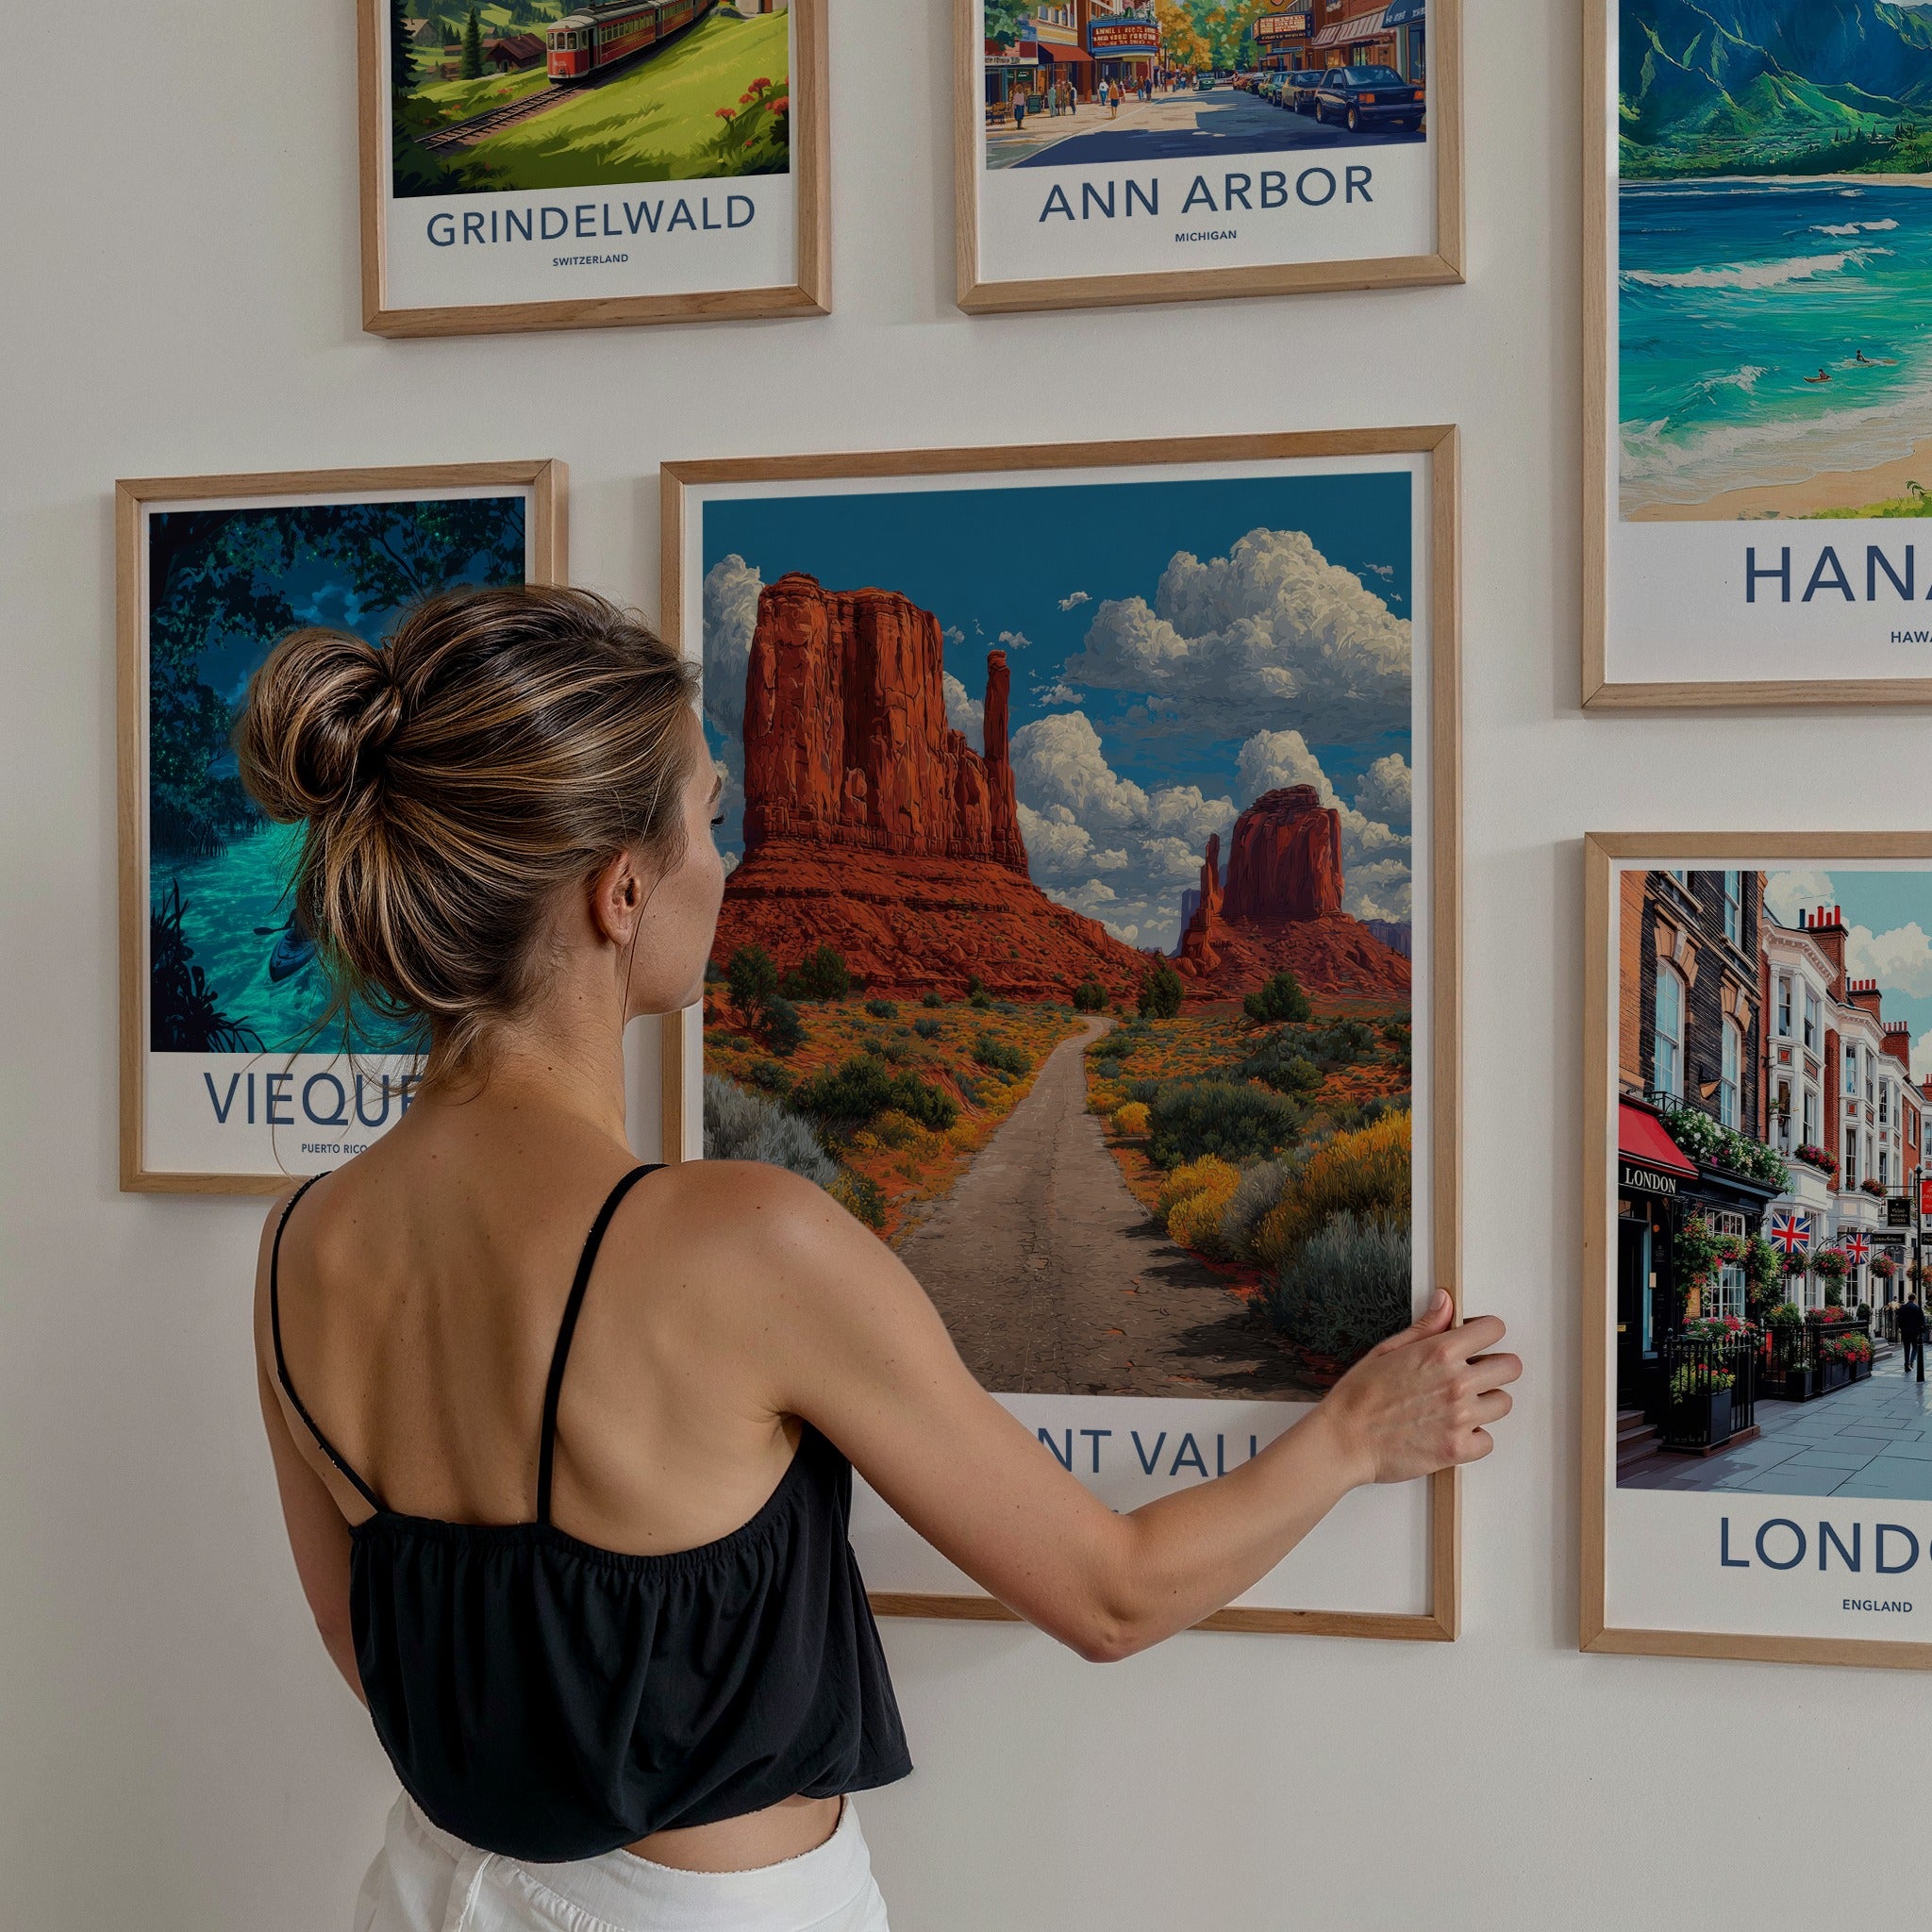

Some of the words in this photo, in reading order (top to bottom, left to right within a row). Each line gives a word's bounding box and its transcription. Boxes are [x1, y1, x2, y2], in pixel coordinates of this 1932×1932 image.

[1039, 178, 1159, 223] ANN
[1181, 165, 1374, 214] ARBOR
[426, 194, 756, 247] GRINDELWALD
[1174, 230, 1238, 242] MICHIGAN
[552, 254, 629, 267] SWITZERLAND
[1745, 544, 1932, 604] HAN
[1890, 631, 1932, 643] HAW
[301, 1143, 341, 1154] PUERTO
[343, 1143, 369, 1155] RICO
[1624, 1167, 1676, 1194] LONDON
[1720, 1517, 1932, 1574] LOND
[1841, 1599, 1914, 1613] ENGLAND
